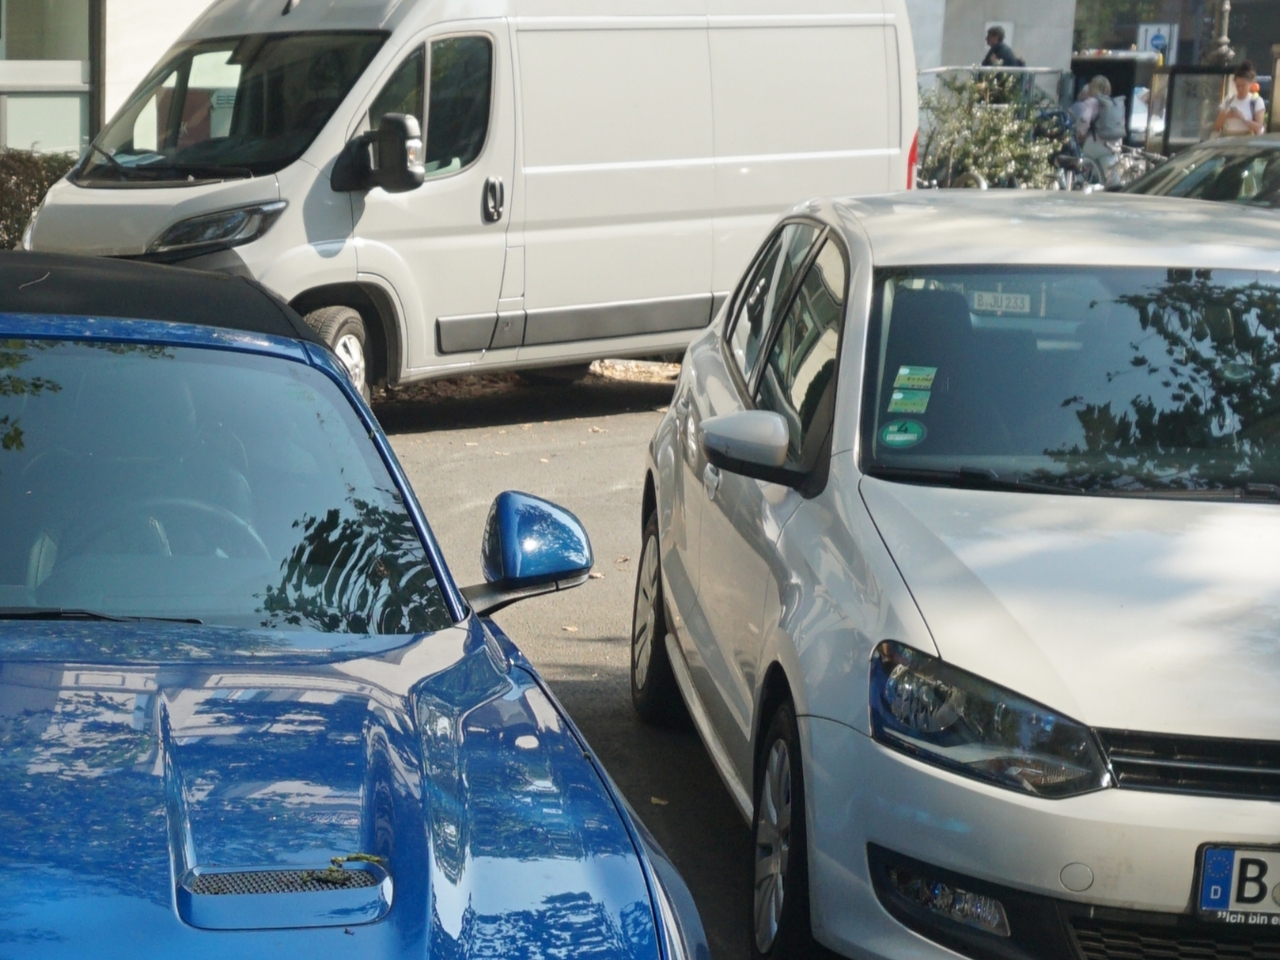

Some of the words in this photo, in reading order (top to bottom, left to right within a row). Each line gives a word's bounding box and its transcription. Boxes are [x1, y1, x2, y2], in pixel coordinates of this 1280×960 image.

[977, 294, 983, 307] B
[897, 421, 909, 433] 4
[1235, 857, 1268, 904] B
[1210, 885, 1221, 899] D
[1248, 913, 1268, 924] bin
